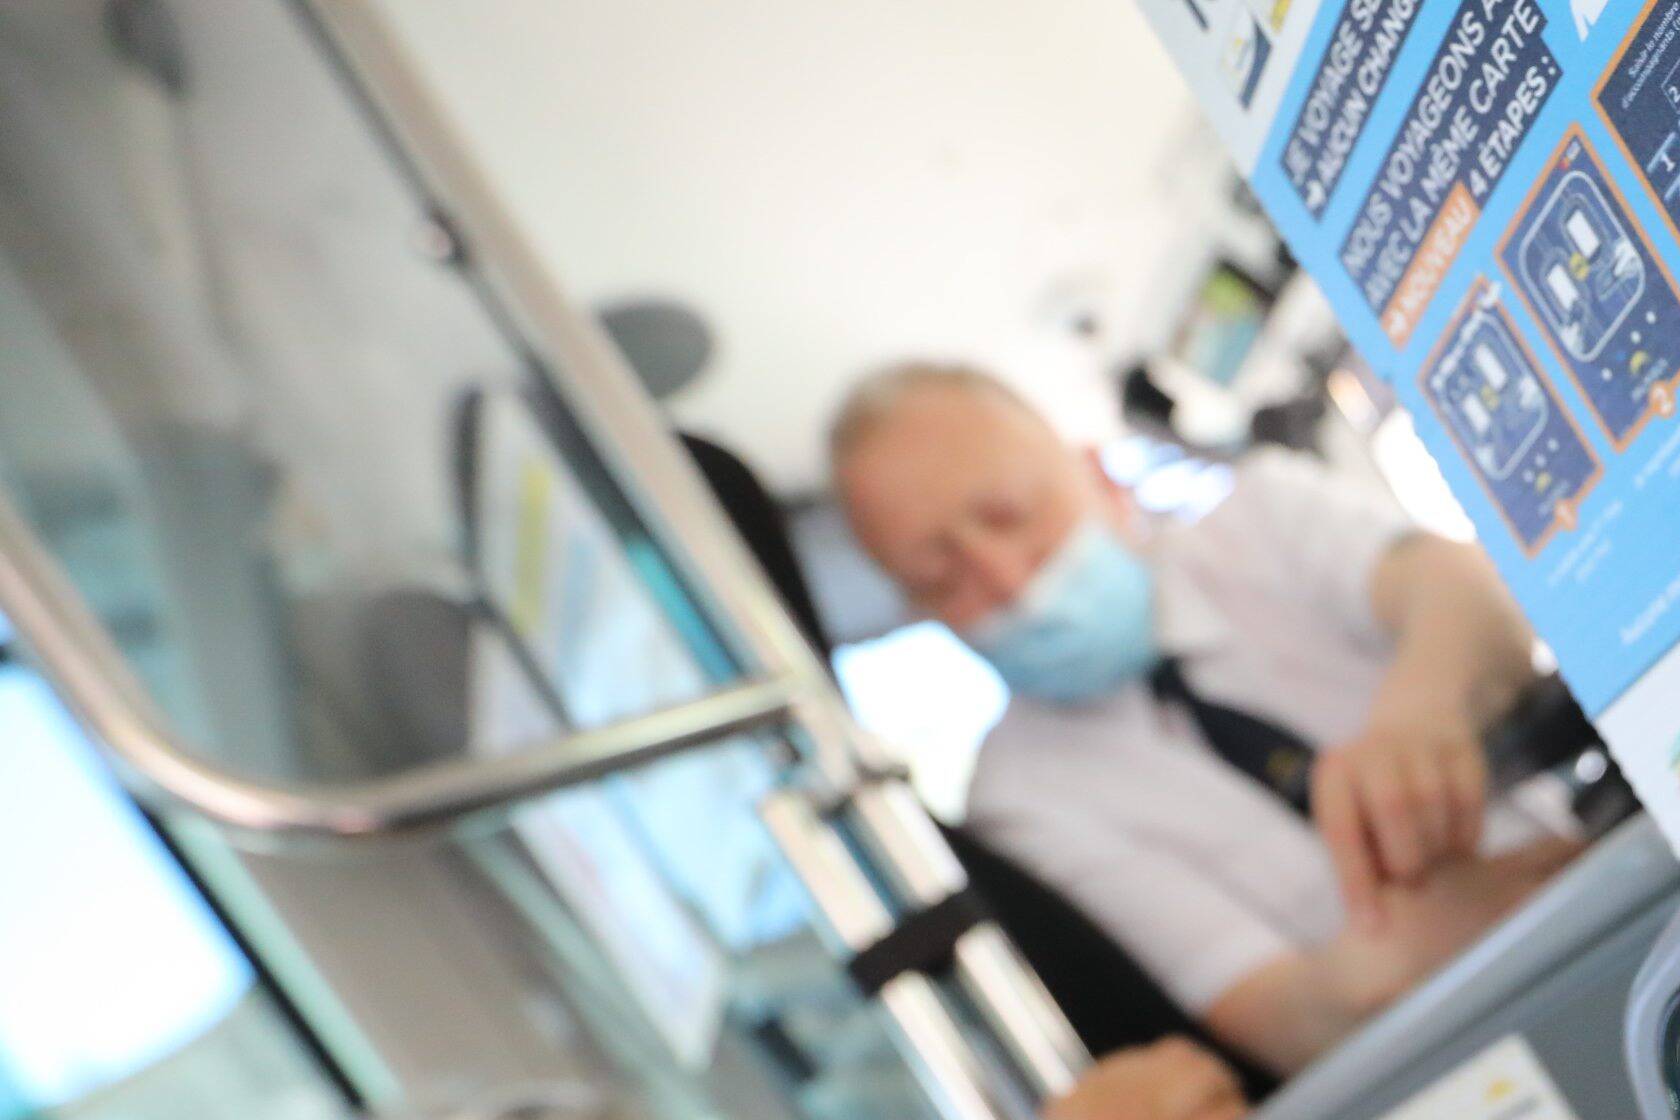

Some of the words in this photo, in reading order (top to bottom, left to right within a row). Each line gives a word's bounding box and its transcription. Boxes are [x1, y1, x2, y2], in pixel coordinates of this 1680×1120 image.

[1301, 20, 1364, 148] VOYAGE
[1317, 88, 1367, 184] AUCUN
[1399, 196, 1434, 243] LA
[1469, 0, 1540, 115] CARTE
[1341, 192, 1393, 279] NOUS
[1380, 11, 1485, 199] VOYAGEONS
[1468, 168, 1488, 198] 4
[1662, 153, 1675, 172] 1
